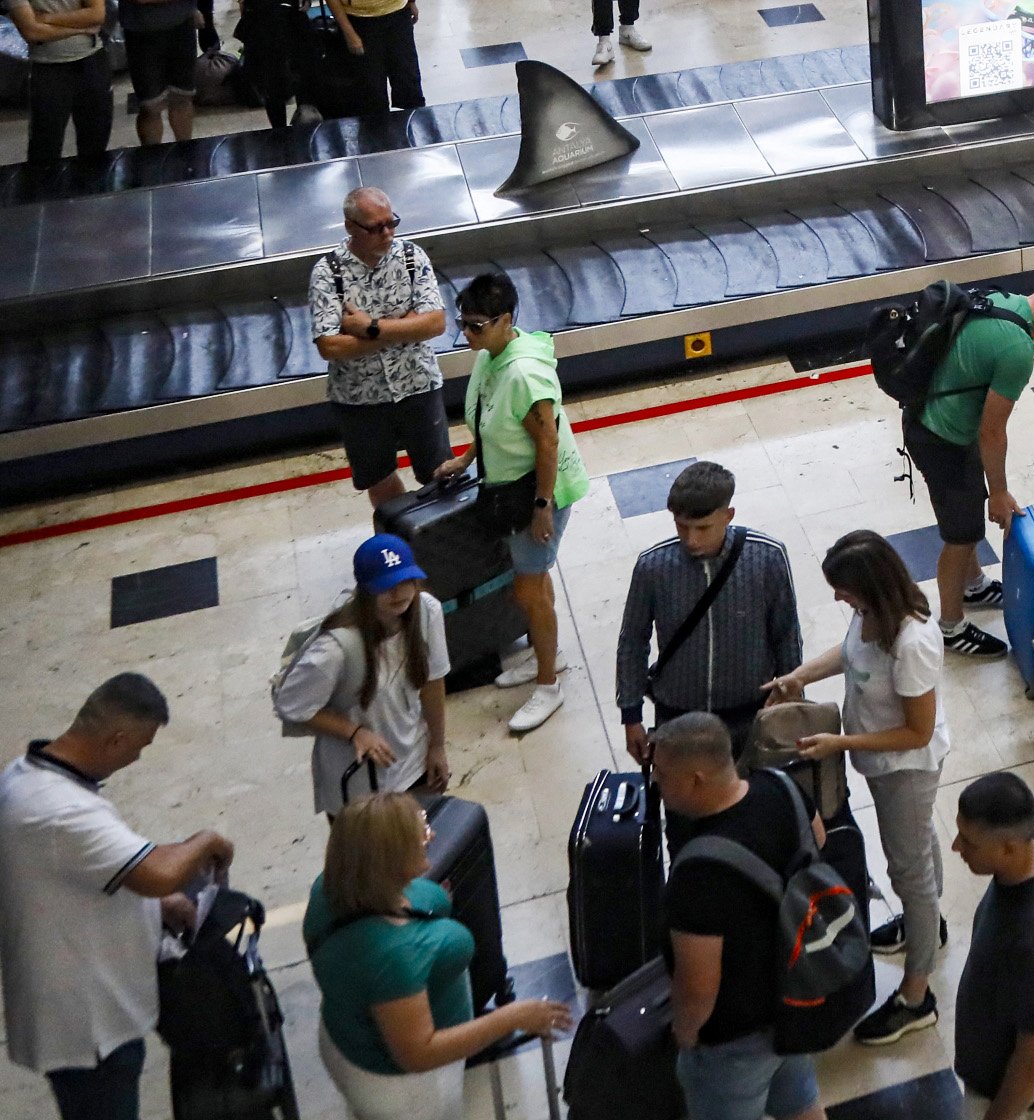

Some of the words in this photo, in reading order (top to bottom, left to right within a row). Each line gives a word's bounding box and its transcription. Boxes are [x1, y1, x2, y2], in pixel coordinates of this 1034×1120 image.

[552, 137, 592, 156] ANTALYA
[552, 145, 594, 164] AQUARIUM
[380, 548, 402, 568] LA
